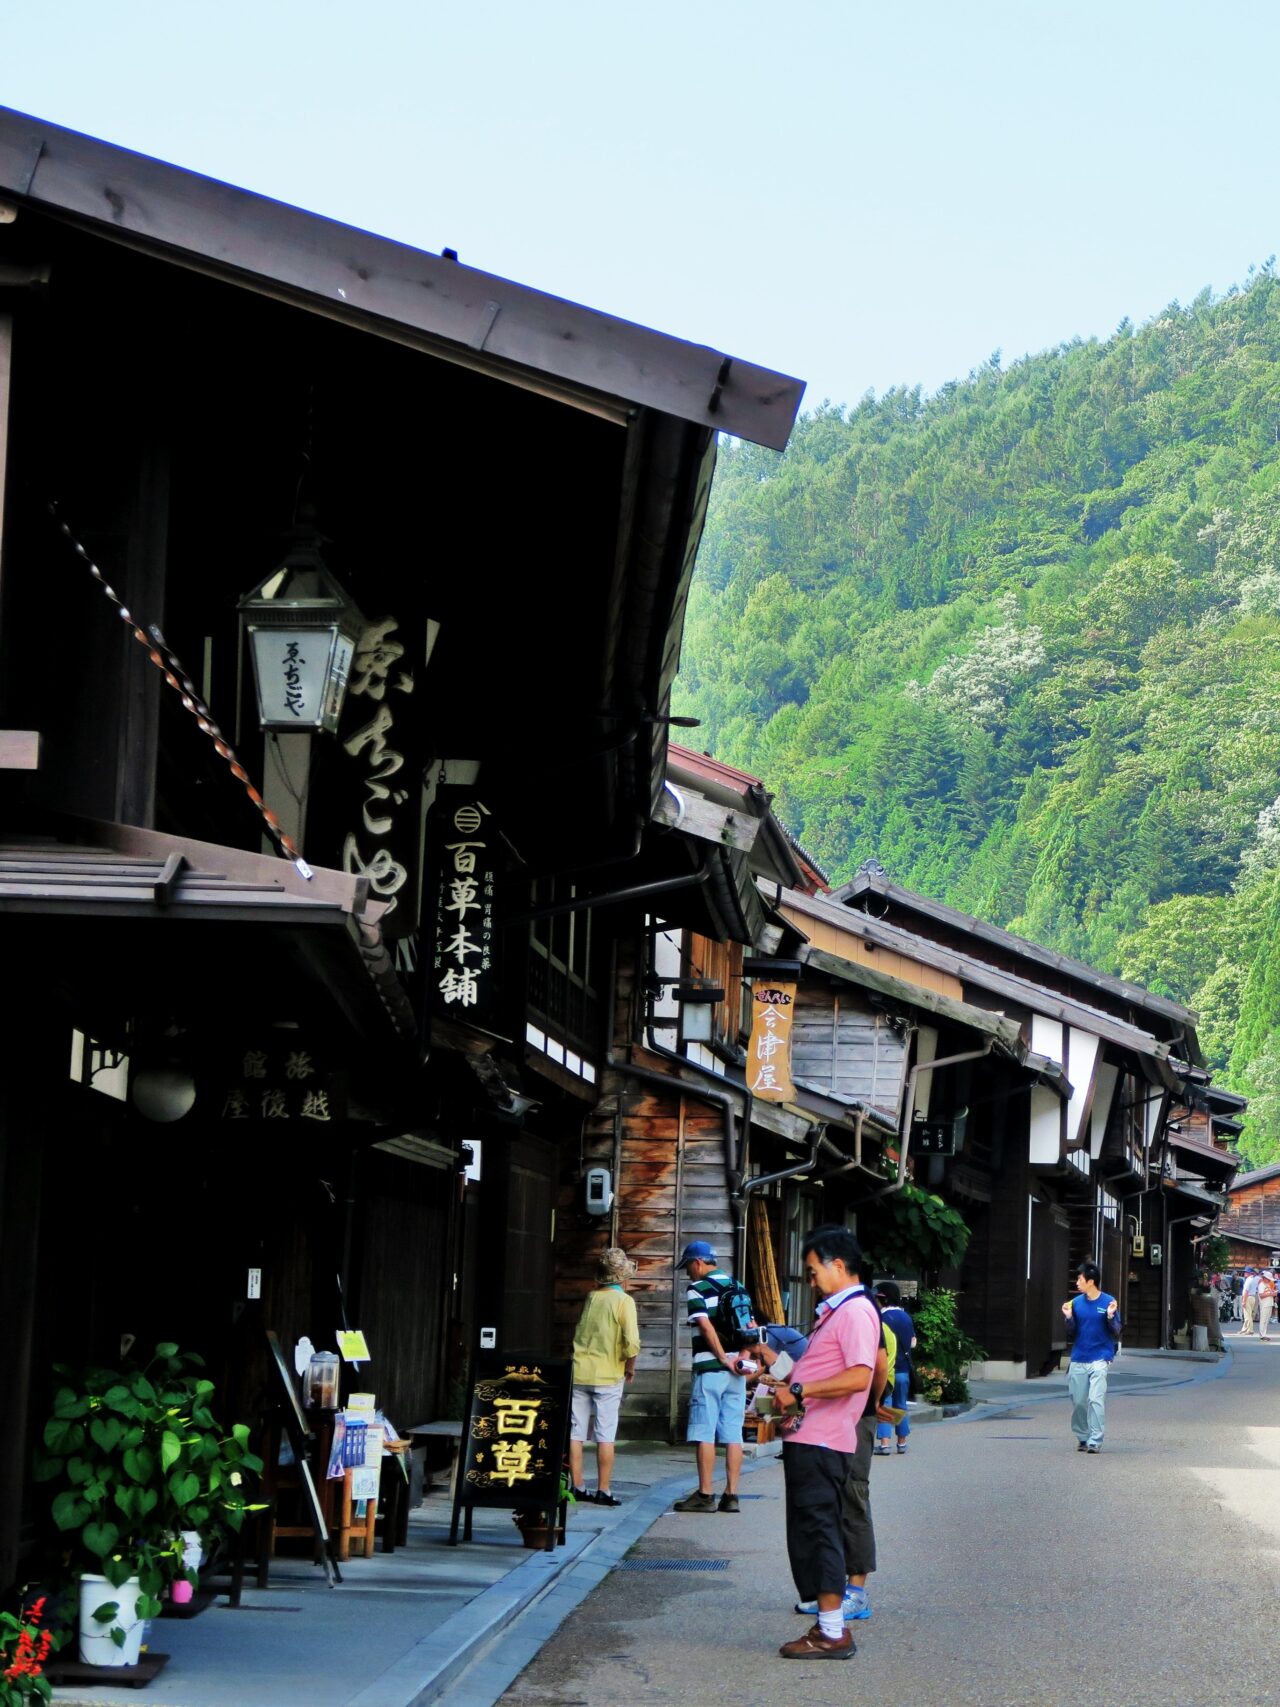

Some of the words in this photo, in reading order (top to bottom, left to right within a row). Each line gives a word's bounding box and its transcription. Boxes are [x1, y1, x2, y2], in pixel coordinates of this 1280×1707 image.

[438, 841, 488, 1008] 百草本舗
[751, 1003, 789, 1092] 会津屋
[489, 1398, 542, 1488] 百草
